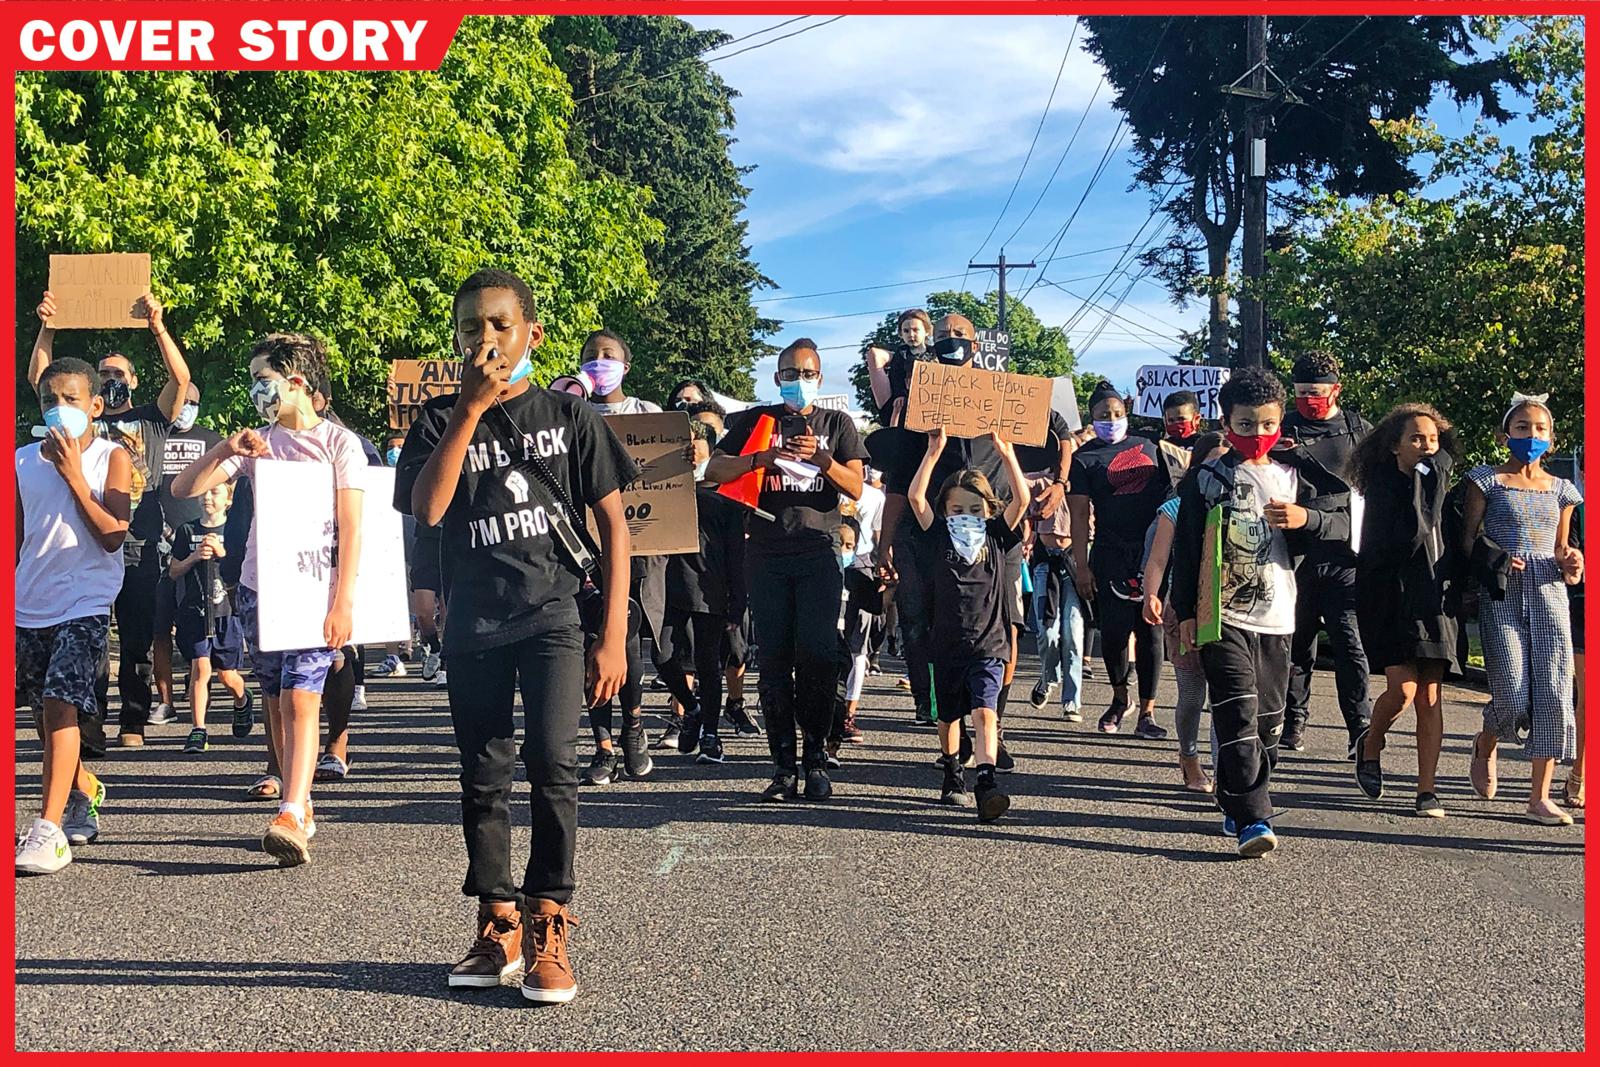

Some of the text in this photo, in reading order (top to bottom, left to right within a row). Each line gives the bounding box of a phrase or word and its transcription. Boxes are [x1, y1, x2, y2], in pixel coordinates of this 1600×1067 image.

[996, 332, 1009, 344] DO
[973, 351, 1007, 372] ACK
[918, 364, 1039, 398] BLACK PEOPLE
[1147, 368, 1190, 387] BLACK
[919, 388, 1026, 415] DESERVE TO
[1143, 387, 1219, 419] MER
[397, 404, 422, 429] FO
[921, 410, 1029, 435] FEEL SAFE
[164, 442, 200, 452] N'T NO
[164, 452, 200, 460] OD LIKE
[469, 516, 501, 549] I'M
[1248, 525, 1259, 537] 01
